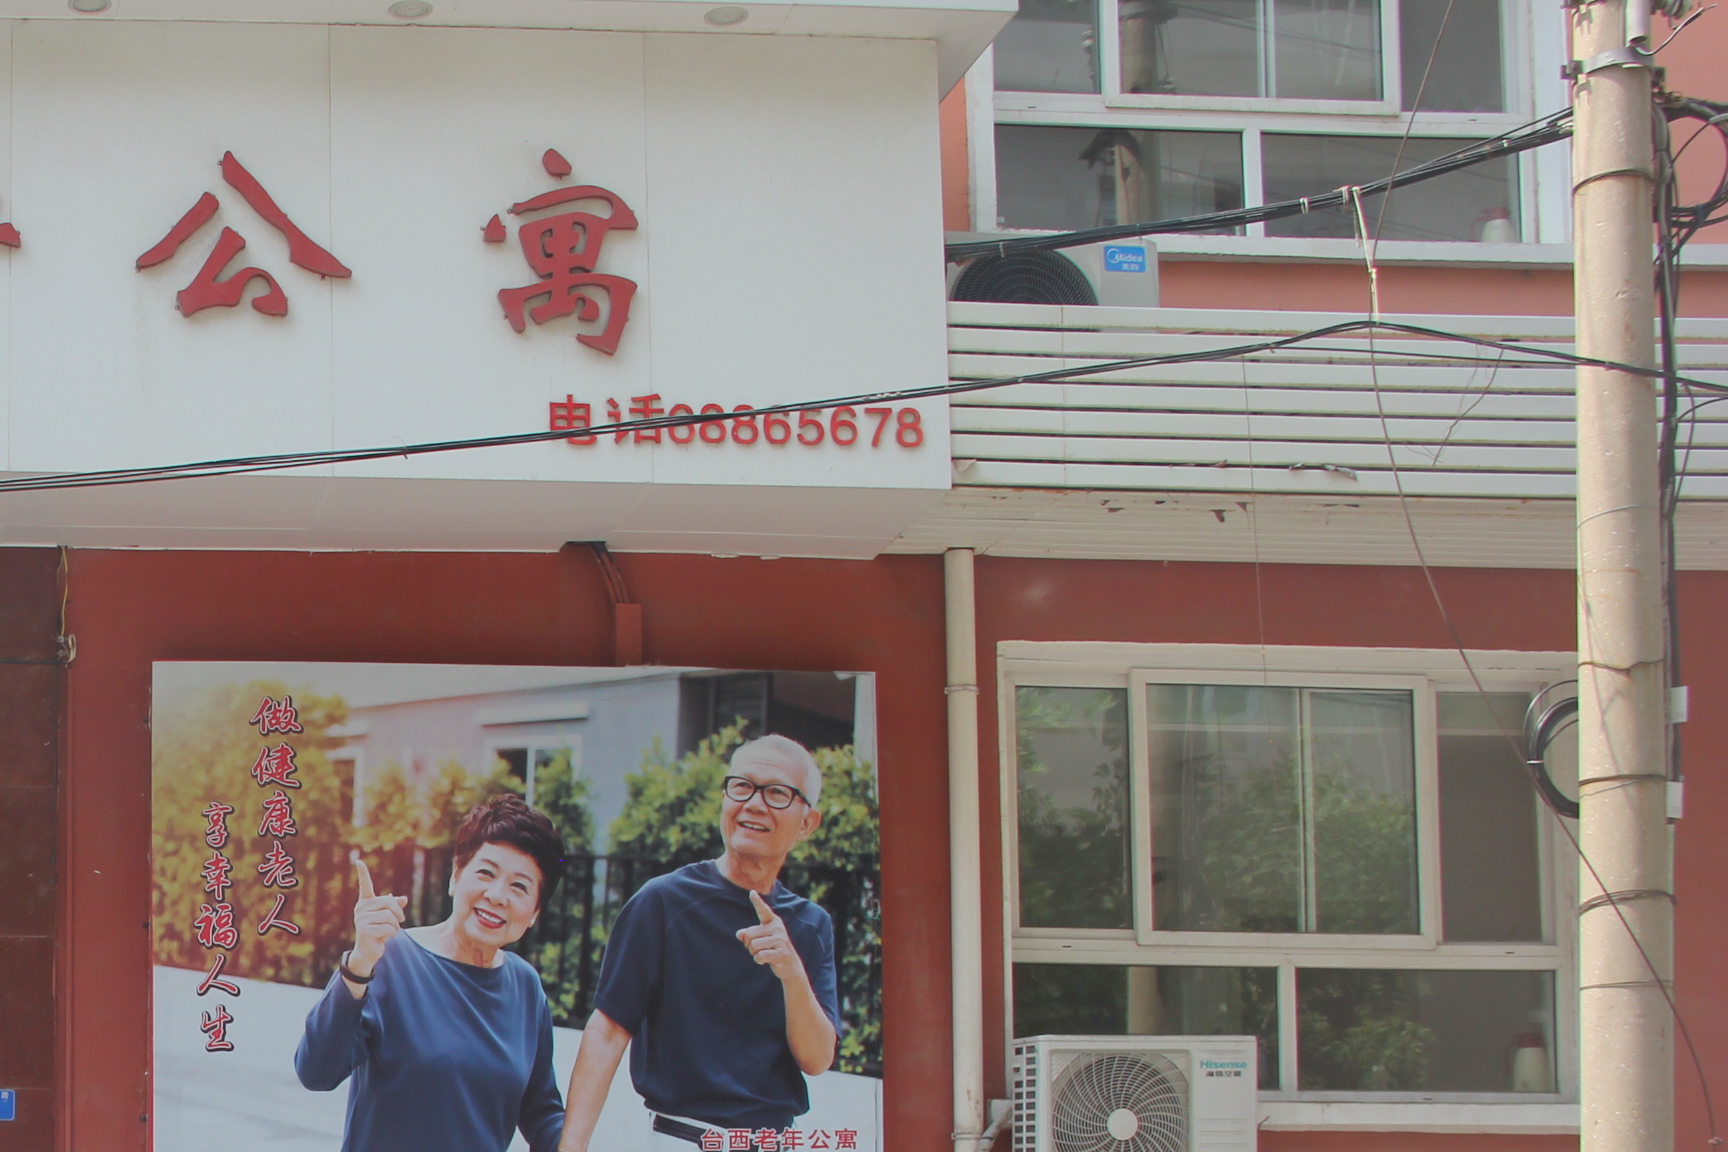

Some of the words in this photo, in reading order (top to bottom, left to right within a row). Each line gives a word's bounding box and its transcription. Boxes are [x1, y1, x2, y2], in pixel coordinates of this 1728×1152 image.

[1114, 252, 1143, 263] Midea
[249, 695, 303, 935] 做健康老人
[194, 801, 240, 1053] 享幸福人生
[1200, 1060, 1248, 1069] Hisense
[700, 1127, 858, 1151] 台西老年公寓
